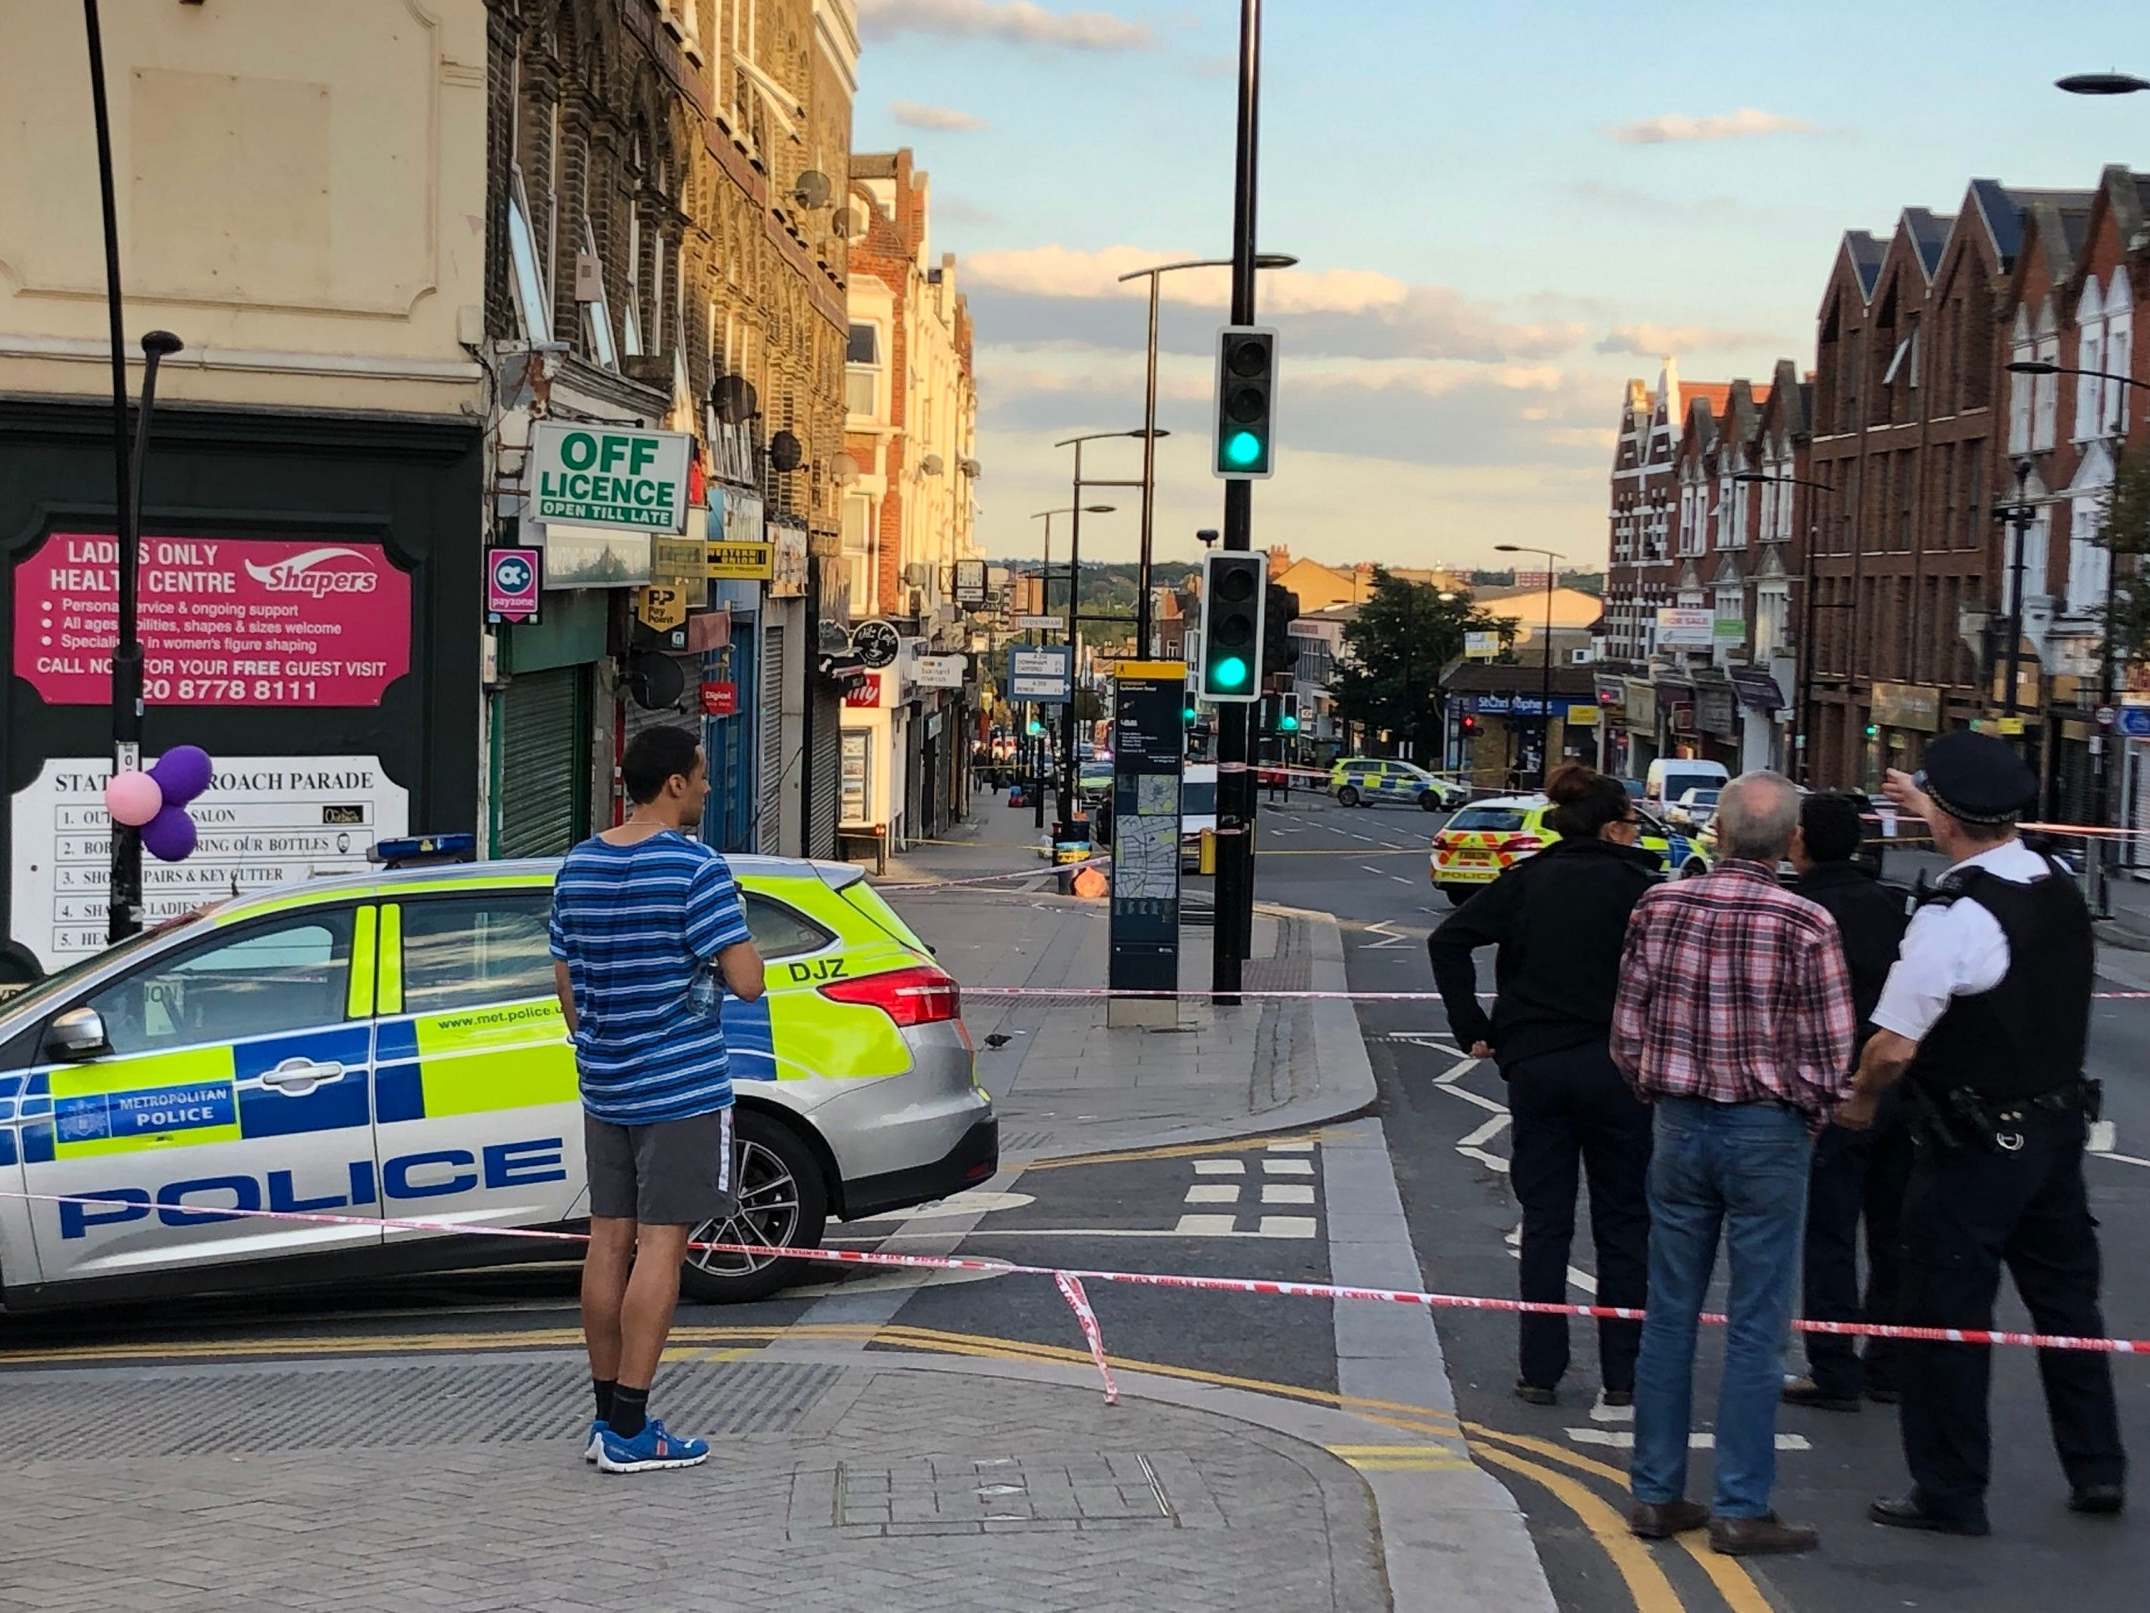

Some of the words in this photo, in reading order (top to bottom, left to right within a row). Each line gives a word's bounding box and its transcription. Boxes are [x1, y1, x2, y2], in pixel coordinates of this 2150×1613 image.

[561, 432, 659, 475] OFF
[541, 471, 675, 507] LICENCE
[543, 501, 586, 517] OPEN
[592, 506, 625, 521] TILL
[631, 510, 669, 524] LATE
[68, 541, 149, 565] LADIS
[158, 543, 218, 566] ONLY
[51, 569, 141, 592] HEALT
[149, 570, 236, 593] CENTRE
[266, 565, 377, 598] Shapers
[62, 599, 119, 612] Persona
[137, 602, 175, 614] ervice
[178, 601, 188, 614] &
[192, 603, 246, 618] ongoing
[249, 604, 299, 619] support
[493, 598, 535, 609] payzone
[63, 616, 81, 629] All
[137, 619, 181, 632] bilities,
[184, 619, 232, 634] shapes
[236, 620, 245, 632] &
[249, 621, 282, 633] sizes
[286, 622, 342, 634] welcome
[148, 637, 159, 648] in
[163, 637, 221, 650] women's
[224, 638, 262, 653] figure
[265, 639, 318, 654] shaping
[37, 657, 85, 673] CALL
[90, 659, 113, 674] NO
[179, 660, 228, 675] YOUR
[233, 660, 280, 676] FREE
[285, 661, 342, 677] GUEST
[347, 662, 387, 677] VISIT
[143, 679, 171, 699] 20
[178, 681, 246, 699] 8778
[254, 681, 317, 700] 8111
[56, 774, 112, 792] STAT
[208, 773, 282, 791] ROACH
[290, 772, 374, 790] PARADE
[192, 809, 237, 823] SALON
[234, 837, 263, 852] OUR
[269, 838, 330, 851] BOTTLES
[84, 871, 111, 884] SHO
[144, 869, 183, 883] PAIRS
[186, 869, 195, 883] &
[200, 869, 226, 881] KEY
[230, 868, 283, 882] CUTTER
[789, 958, 848, 982] DJZ
[438, 1006, 563, 1029] www.met.police.u
[120, 1088, 227, 1111] METROPOLITAN
[136, 1106, 214, 1127] POLICE
[59, 1137, 567, 1239] POLICE
